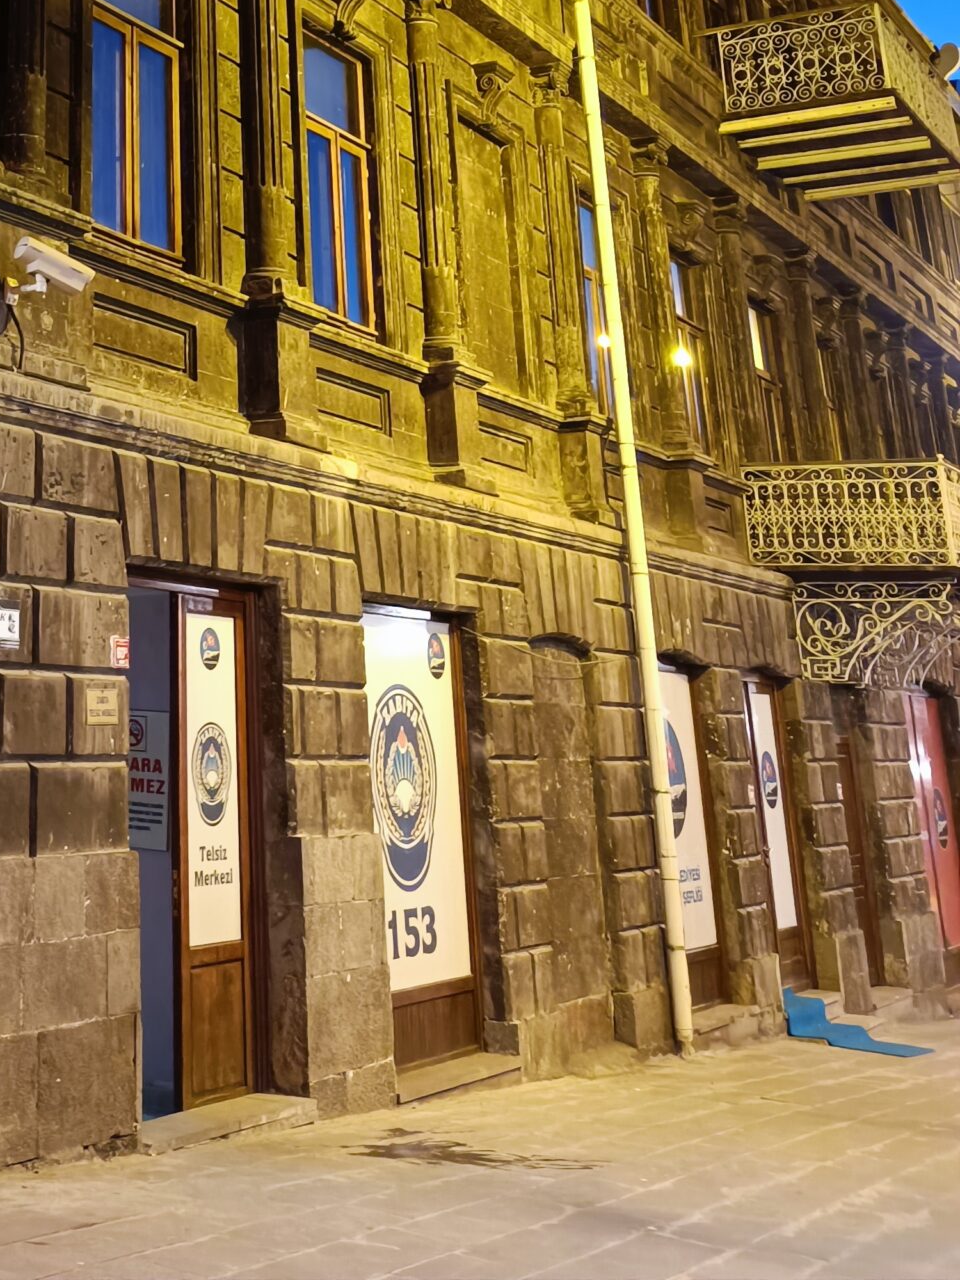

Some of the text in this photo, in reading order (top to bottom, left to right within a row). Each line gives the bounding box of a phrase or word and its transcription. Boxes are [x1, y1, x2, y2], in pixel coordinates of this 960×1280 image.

[381, 694, 419, 728] ZABITA
[129, 757, 163, 774] ARA
[199, 844, 228, 862] Telsiz
[194, 867, 233, 887] Merkezi
[387, 905, 438, 960] 153
